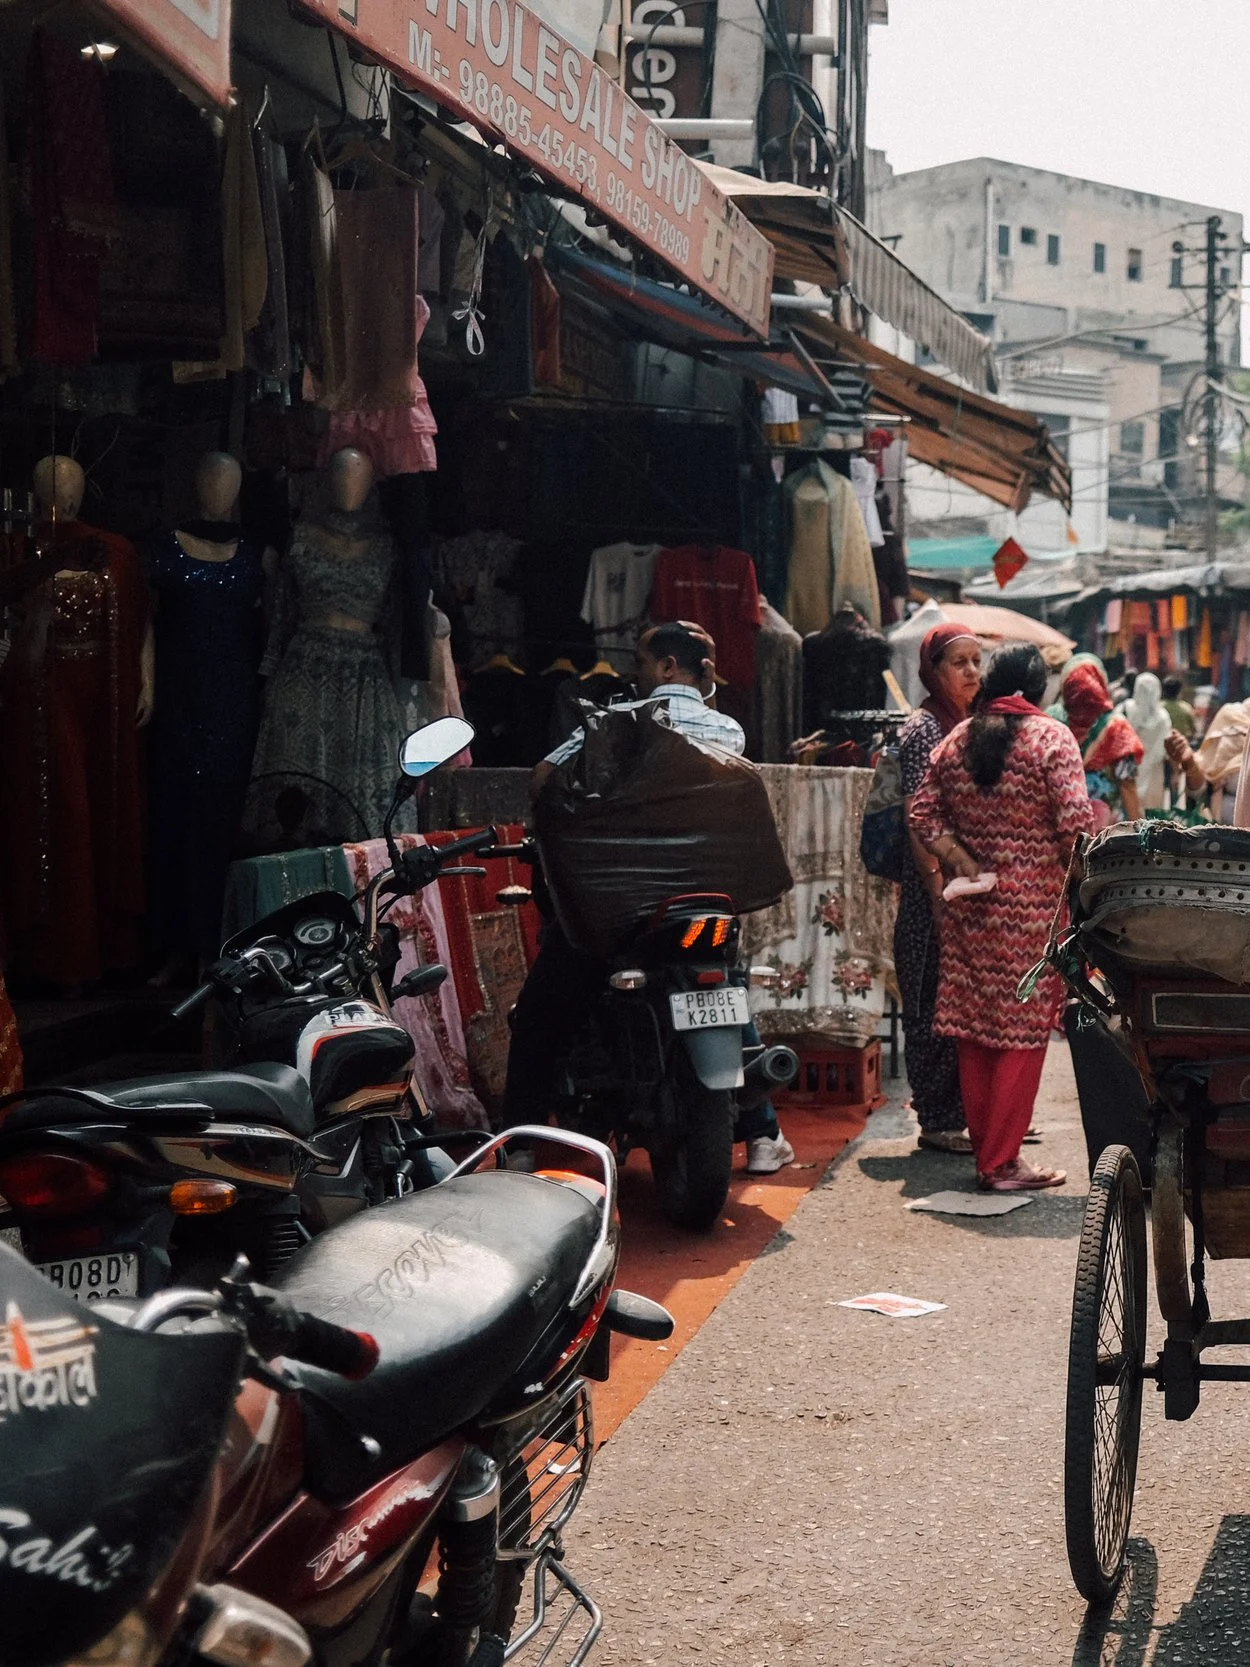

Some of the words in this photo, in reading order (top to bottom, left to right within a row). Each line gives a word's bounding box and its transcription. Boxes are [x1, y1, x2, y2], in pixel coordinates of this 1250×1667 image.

[426, 0, 636, 173] HOLESALE
[641, 124, 702, 223] SHOP
[686, 992, 735, 1008] PB08E
[688, 1008, 737, 1026] K2811
[40, 1256, 121, 1289] B08D
